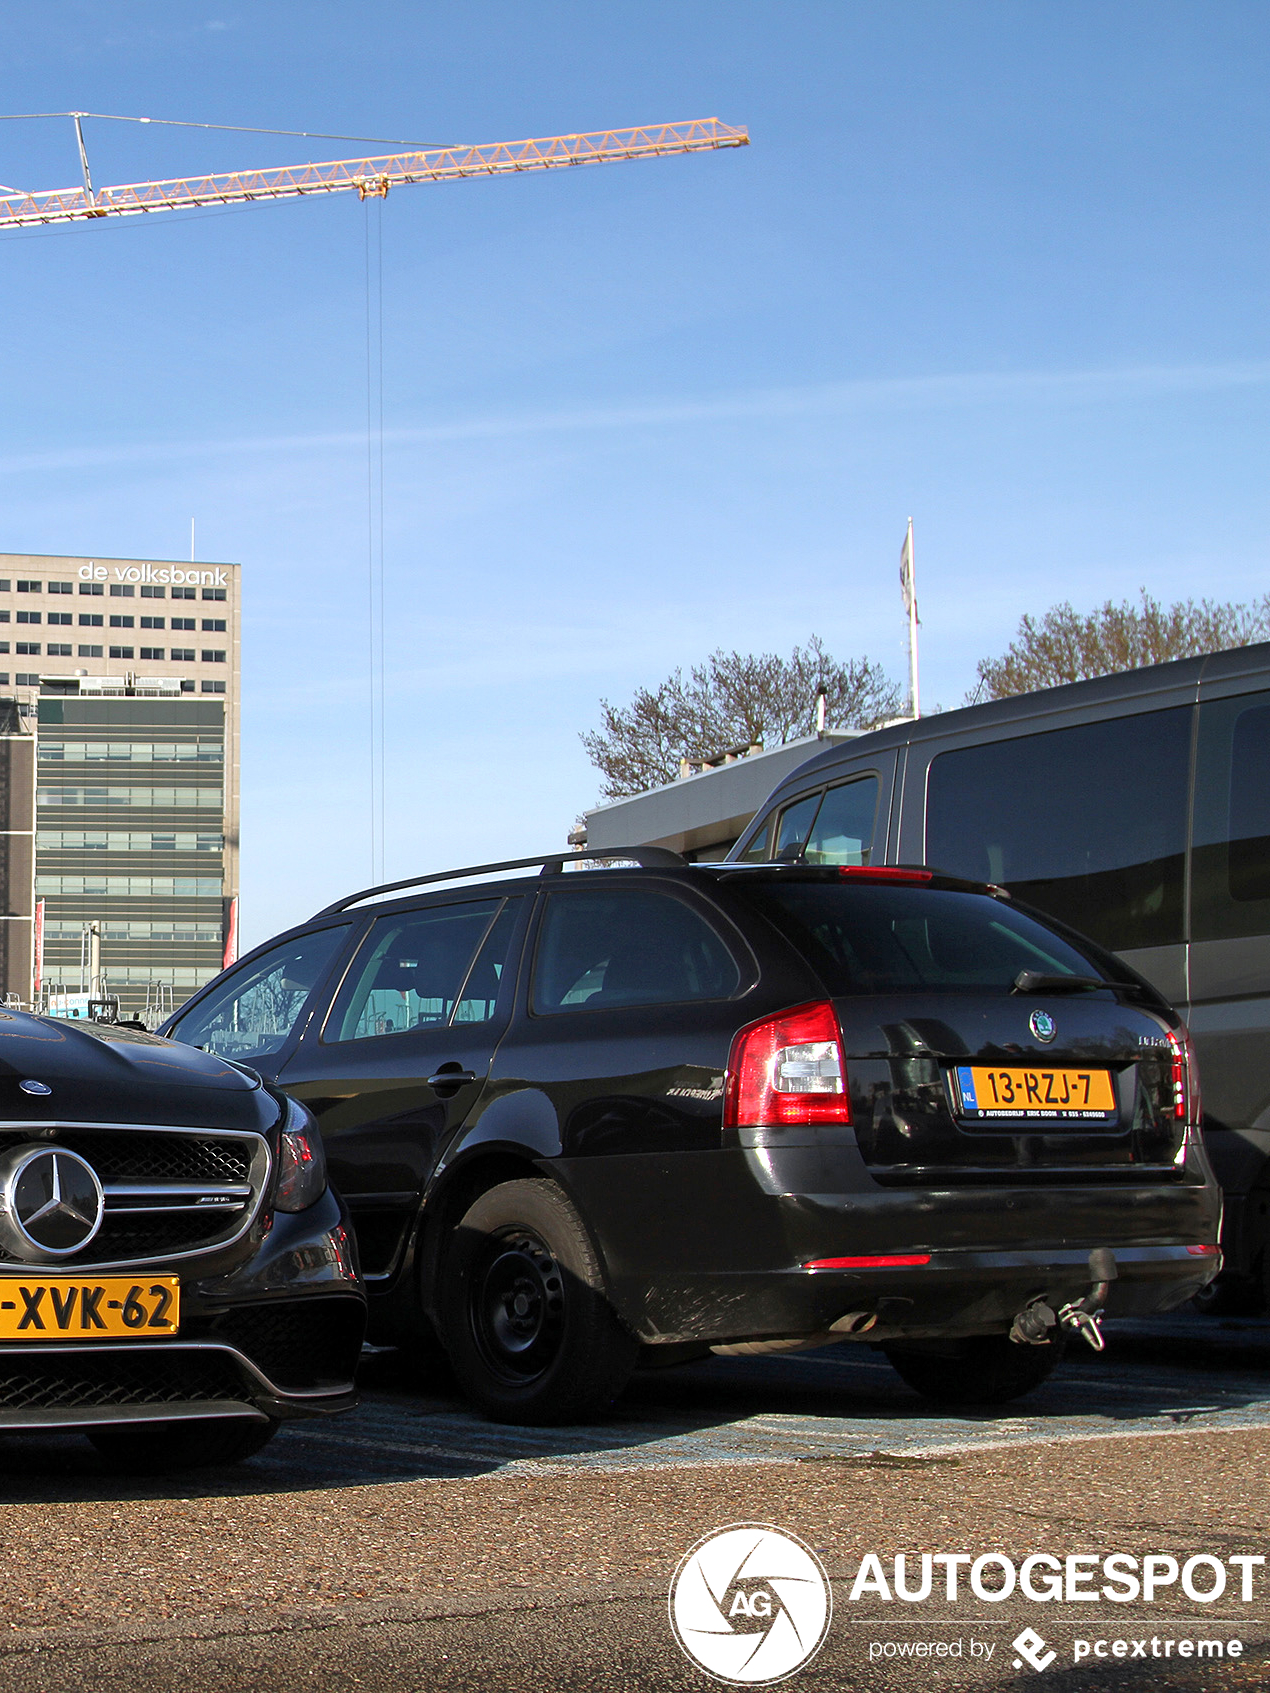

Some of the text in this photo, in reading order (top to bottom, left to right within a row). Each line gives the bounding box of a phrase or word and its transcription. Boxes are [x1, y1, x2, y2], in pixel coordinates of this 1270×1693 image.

[78, 561, 228, 586] de volksbank
[962, 1092, 975, 1102] NL
[987, 1072, 1091, 1104] 13-RZJ-7
